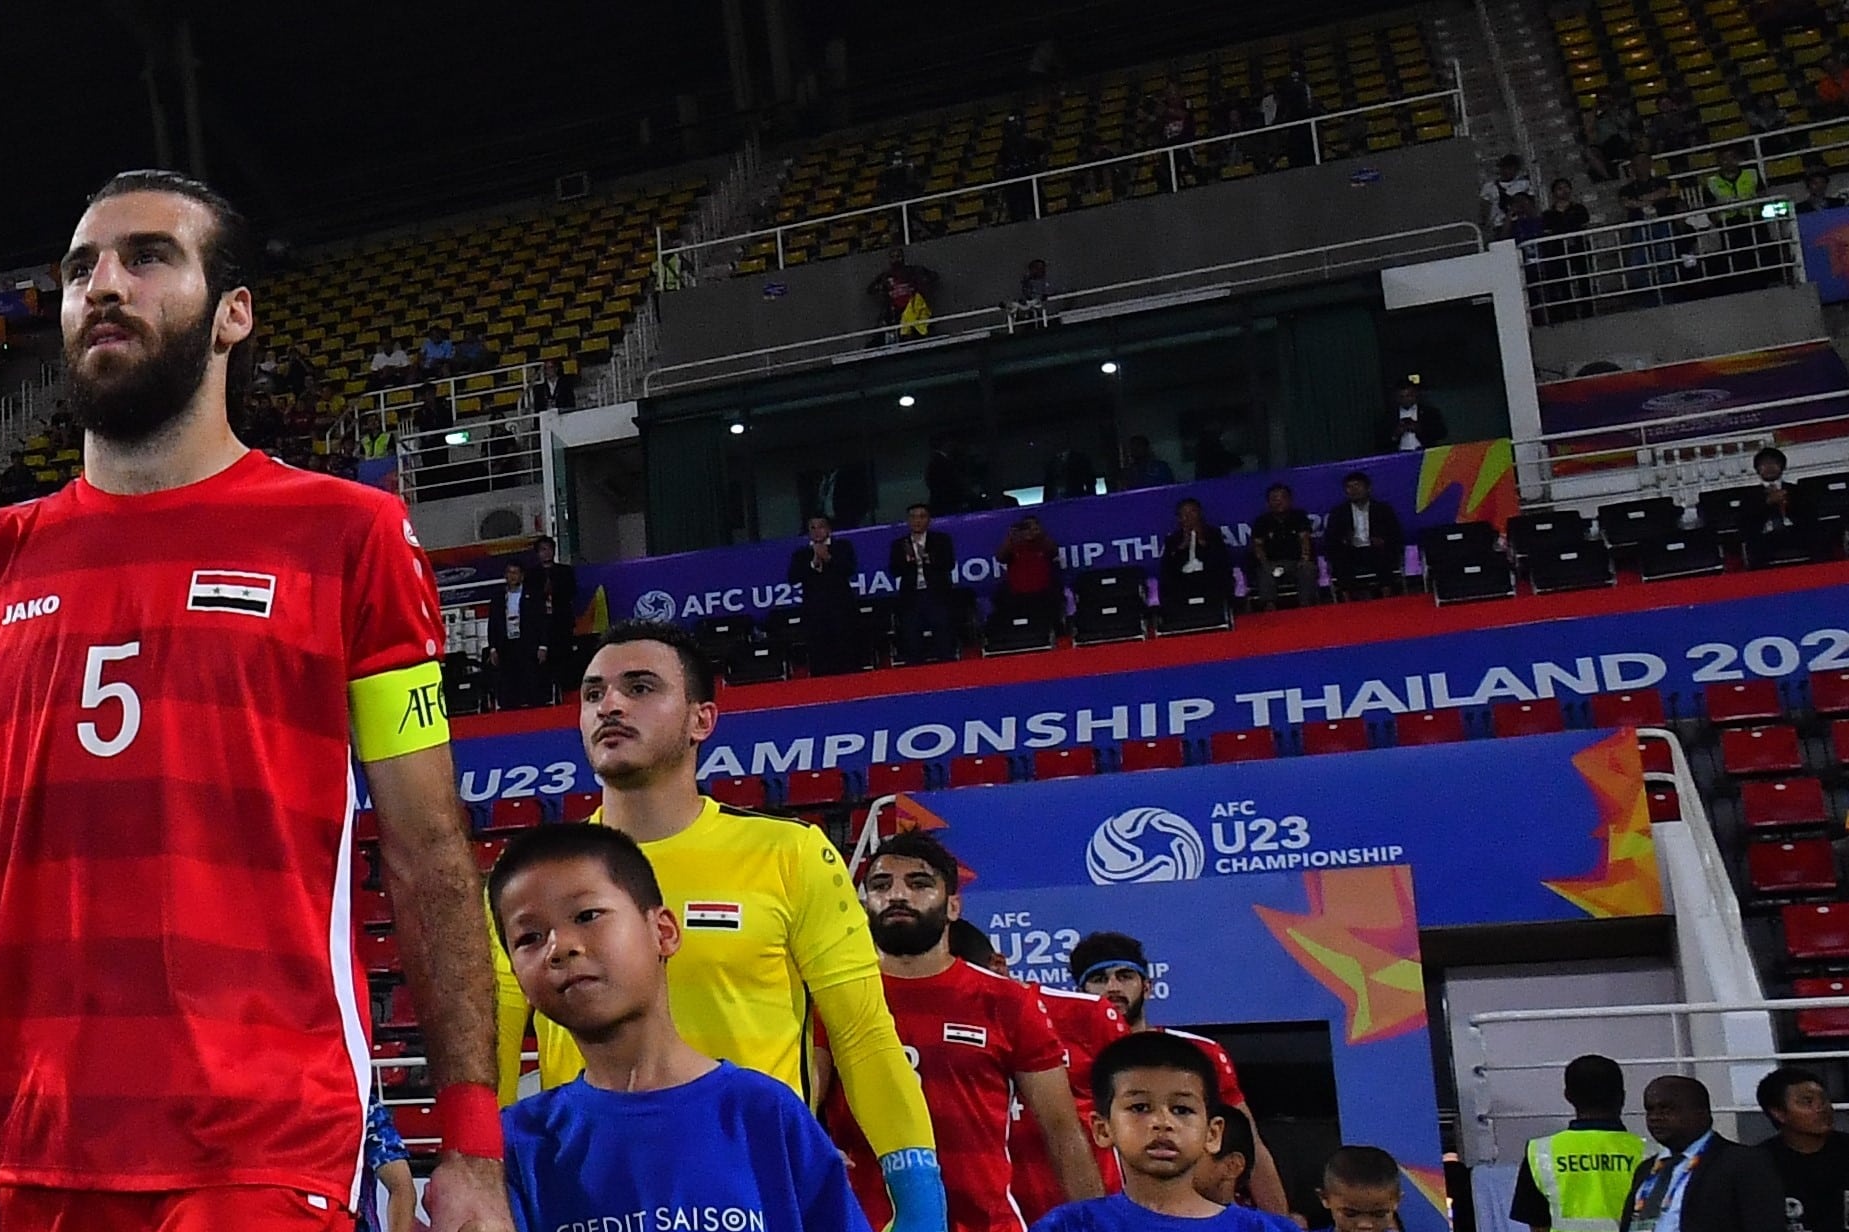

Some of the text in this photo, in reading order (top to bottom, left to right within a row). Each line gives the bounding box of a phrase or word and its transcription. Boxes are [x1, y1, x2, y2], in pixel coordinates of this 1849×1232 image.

[2, 595, 60, 625] JAKO
[681, 588, 744, 618] AFC
[77, 641, 141, 757] 5
[460, 760, 578, 802] U23
[1235, 652, 1668, 727] THAILAND
[1211, 800, 1256, 819] AFC
[1212, 815, 1311, 855] U23
[1215, 845, 1403, 874] CHAMPIONSHIP
[990, 911, 1032, 929] AFC
[1556, 1154, 1635, 1172] SECURITY
